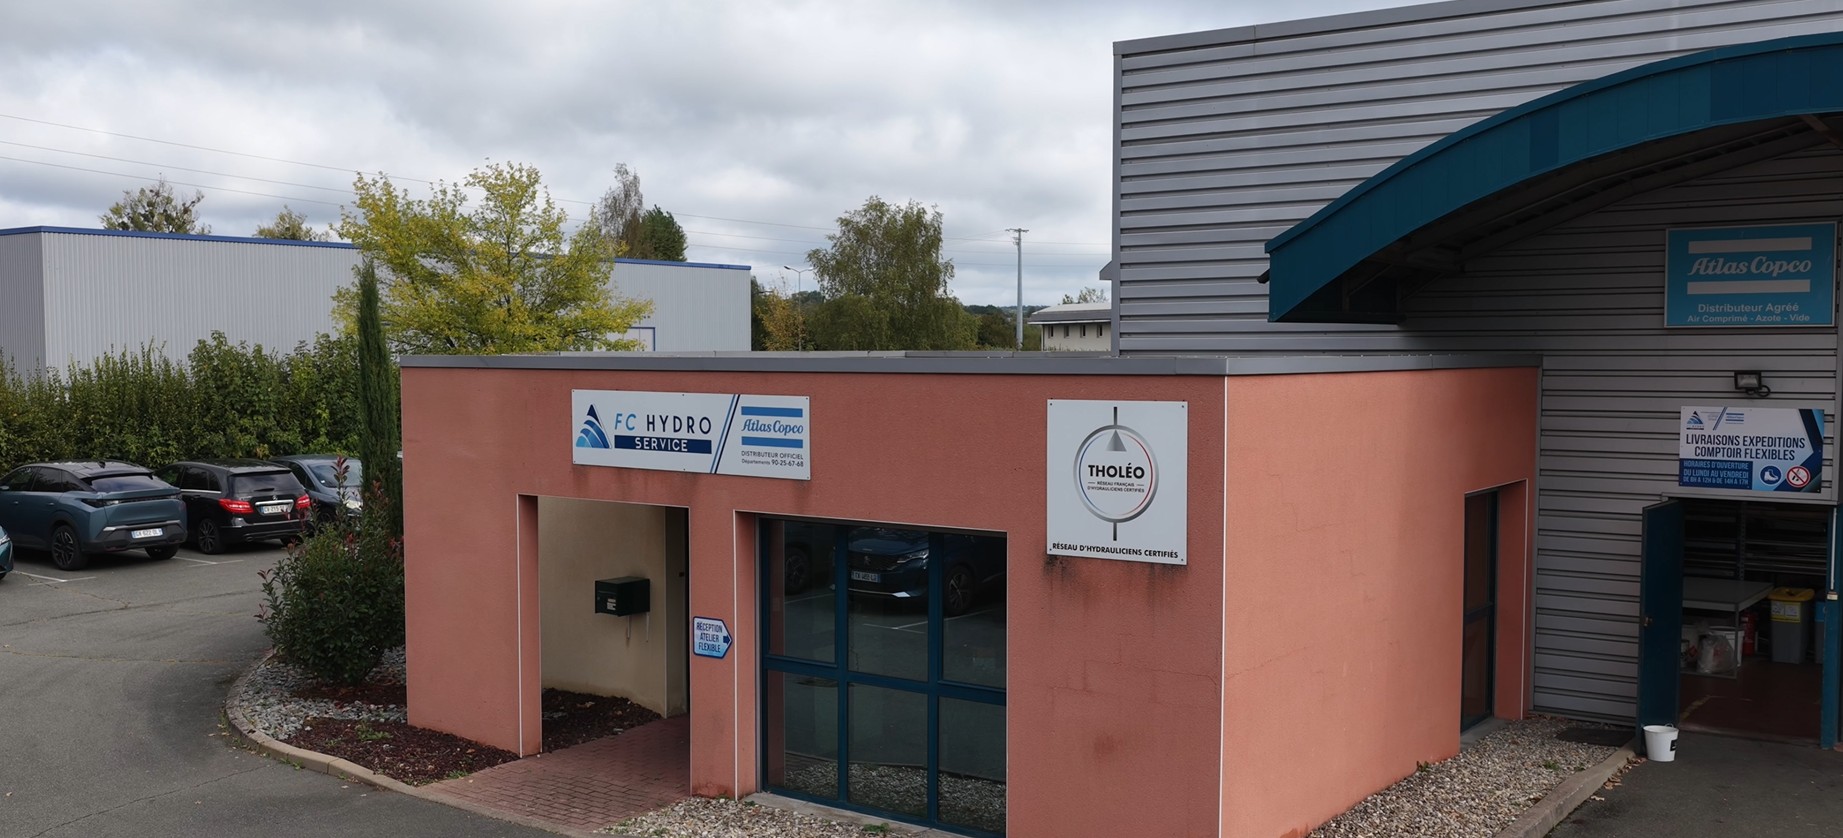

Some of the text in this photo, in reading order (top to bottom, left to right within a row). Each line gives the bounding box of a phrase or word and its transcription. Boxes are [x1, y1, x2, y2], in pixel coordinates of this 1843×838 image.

[1687, 256, 1812, 277] Atlas Copco
[1698, 302, 1799, 314] Distributeur Agréé
[1702, 314, 1748, 323] Comprimé
[615, 413, 711, 434] FC HYDRO
[741, 419, 803, 436] Atlas Copco
[635, 437, 688, 451] SERVICE
[1686, 434, 1805, 448] LIVRAISONS EXPEDITIONS
[741, 450, 778, 458] DISTRIBUTEUR
[1694, 446, 1795, 460] COMPTOIR FLEXIBLES
[771, 459, 804, 467] 90-25-67-68
[1683, 460, 1749, 469] HORAIRES D'OUVERTURE
[1088, 462, 1145, 479] THOLÉO
[1720, 470, 1749, 478] VENDREDI
[1052, 541, 1178, 558] RÉSEAU D'HYDRAULICIENS CERTIFIÉS
[700, 632, 719, 642] ATELIER
[699, 642, 720, 653] FLEXIBLE
